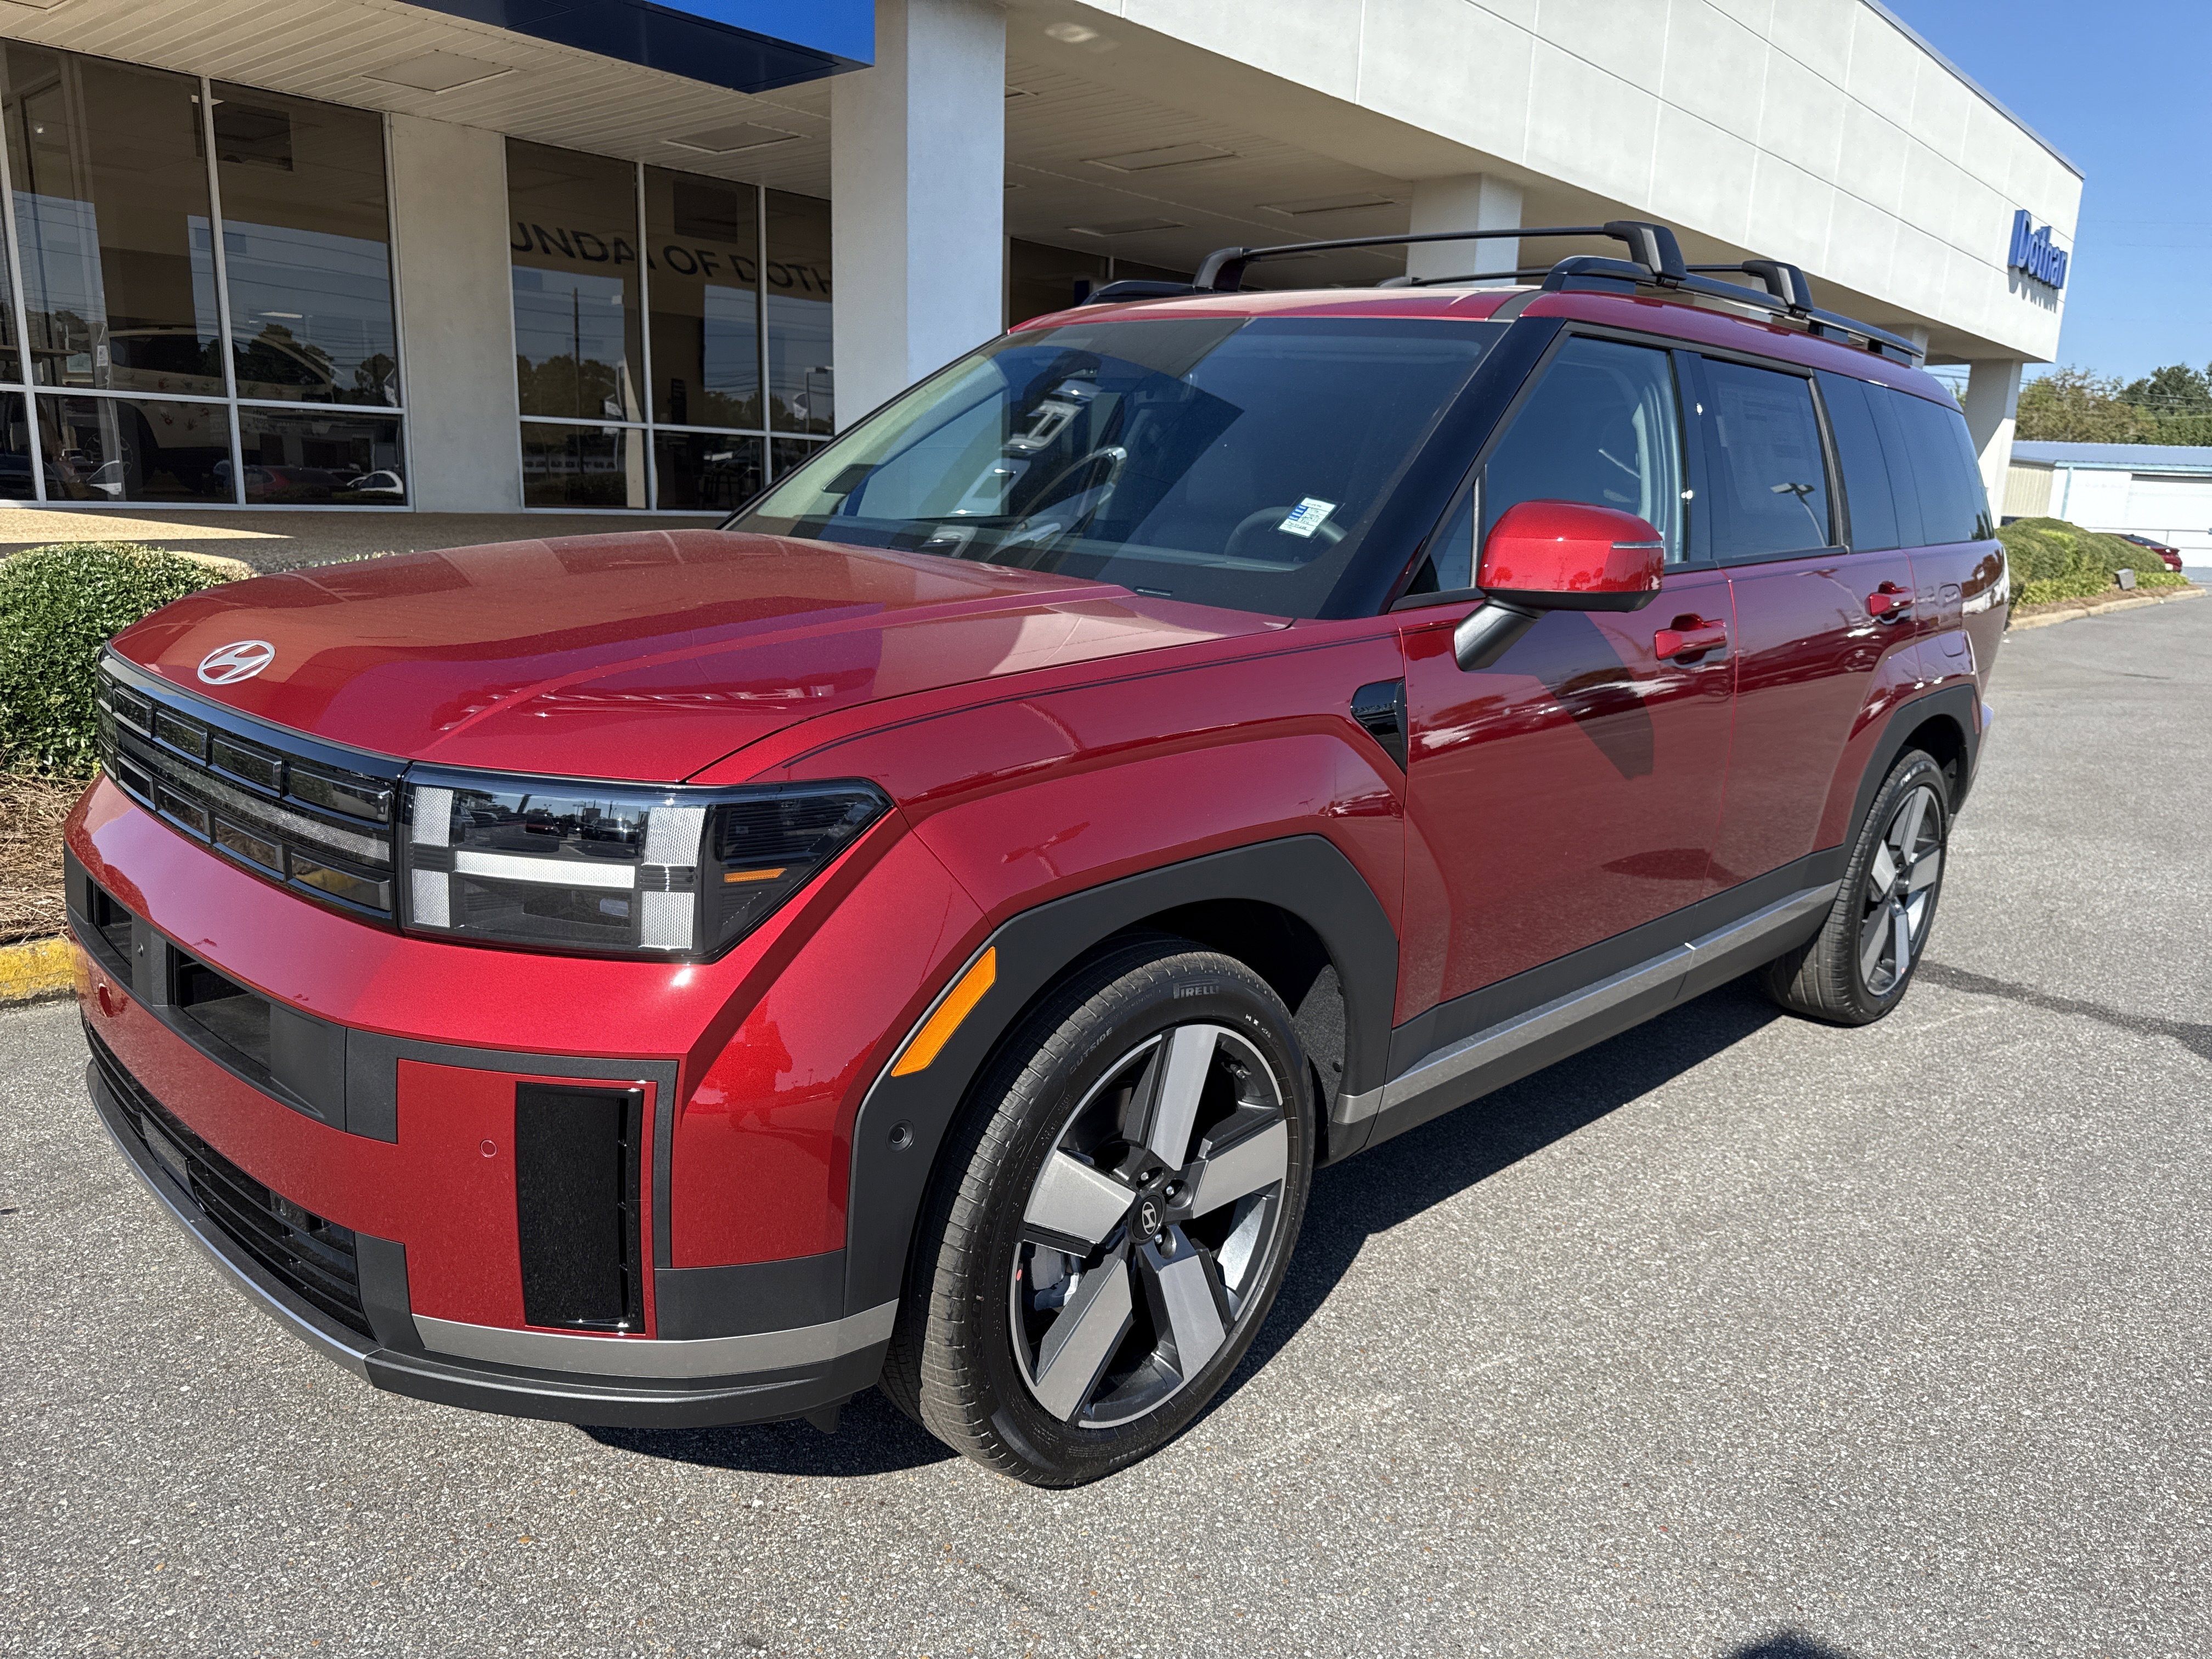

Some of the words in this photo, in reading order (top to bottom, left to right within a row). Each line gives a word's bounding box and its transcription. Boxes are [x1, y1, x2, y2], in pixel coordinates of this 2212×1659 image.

[663, 245, 720, 277] OF
[1173, 978, 1220, 999] PIRELLI
[1070, 1027, 1113, 1075] OUTSIDE
